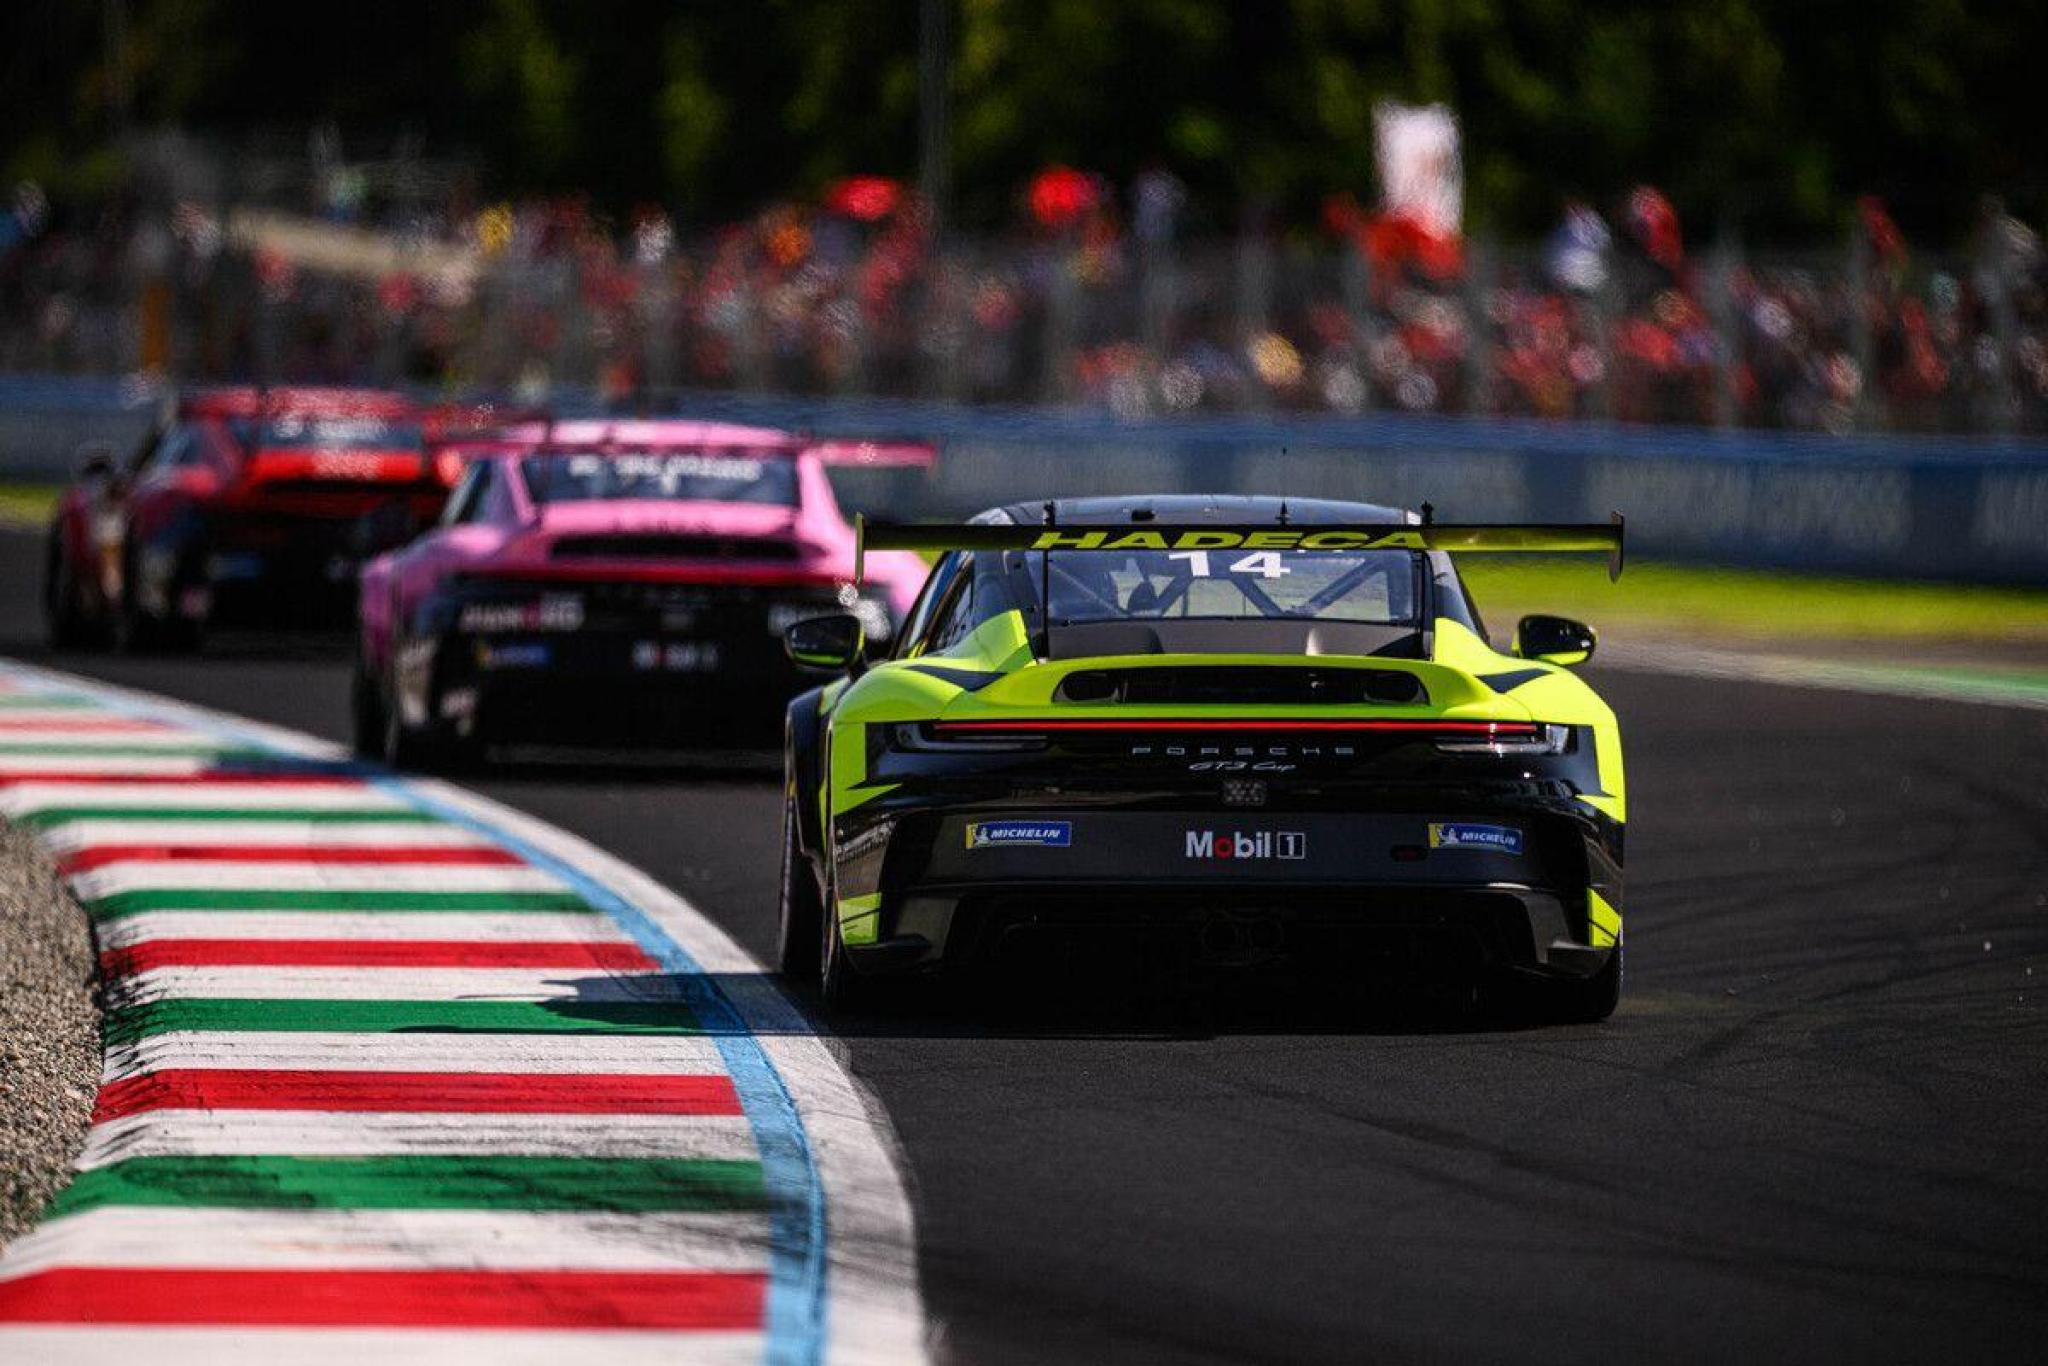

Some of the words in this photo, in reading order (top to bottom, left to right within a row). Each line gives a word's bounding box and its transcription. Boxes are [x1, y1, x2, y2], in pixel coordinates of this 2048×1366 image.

[1031, 532, 1429, 549] HADECA
[1168, 551, 1291, 578] 14
[1132, 747, 1355, 756] PORSCHE
[990, 828, 1061, 839] MICHELIN
[1461, 832, 1517, 846] MICHELIN
[1185, 831, 1271, 858] Mobil
